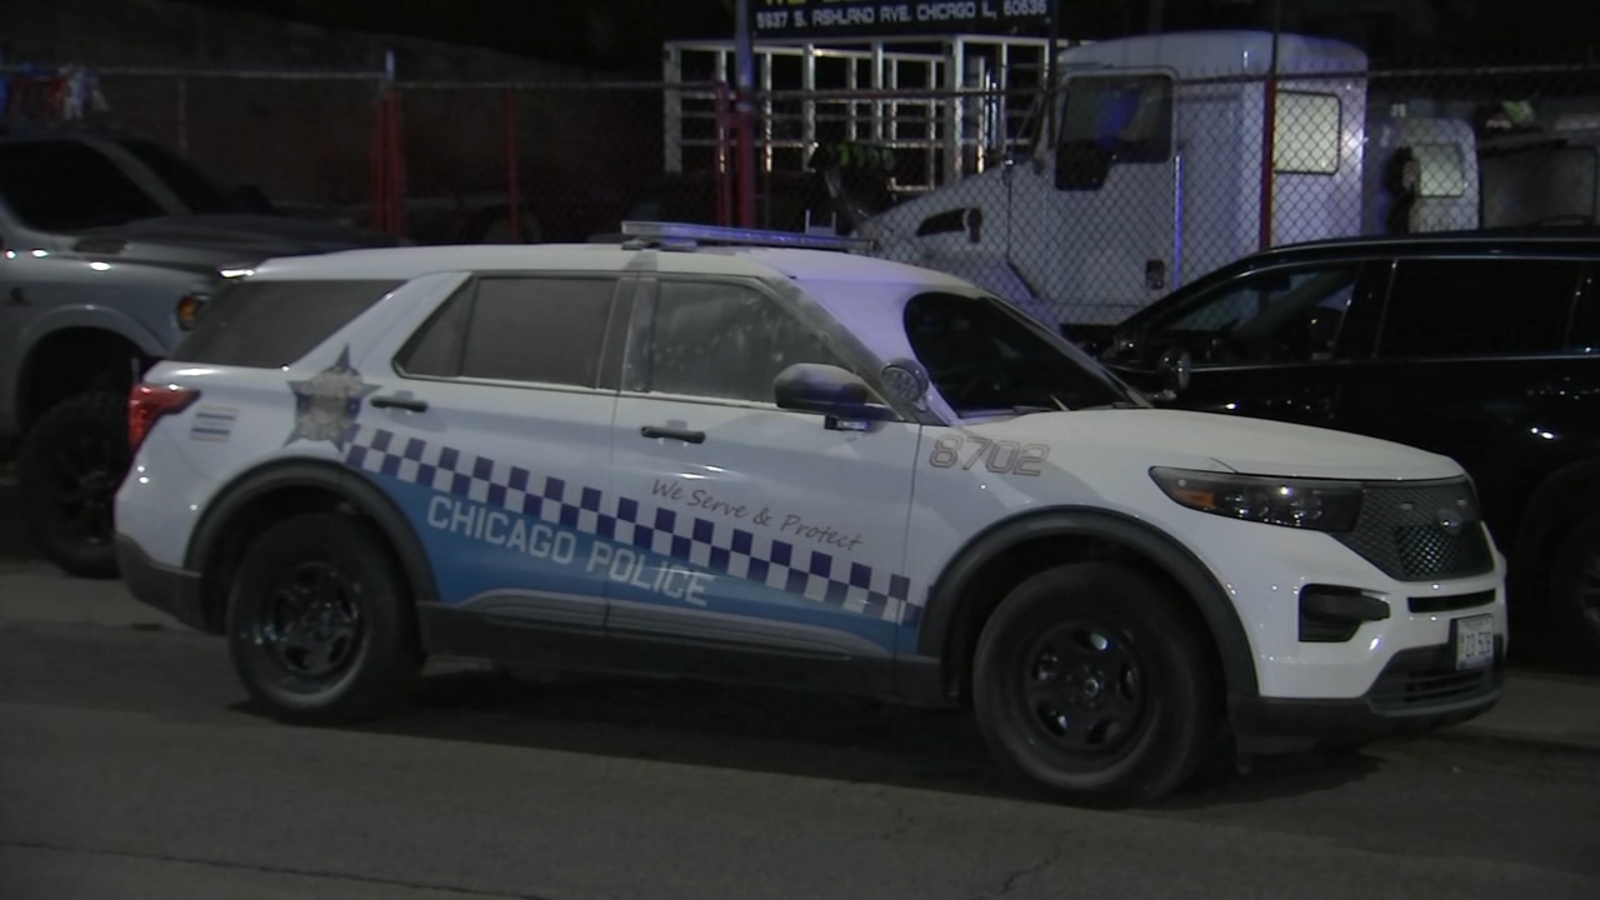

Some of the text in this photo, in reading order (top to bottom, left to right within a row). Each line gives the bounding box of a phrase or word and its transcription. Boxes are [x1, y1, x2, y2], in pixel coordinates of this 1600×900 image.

[793, 9, 807, 28] S.
[812, 5, 875, 26] ASHLAND
[880, 4, 911, 22] AVE.
[916, 2, 976, 21] CHICAGO
[929, 434, 1051, 477] 8702
[649, 479, 863, 552] We Serve & Protect
[427, 495, 709, 607] CHICAGO POLICE
